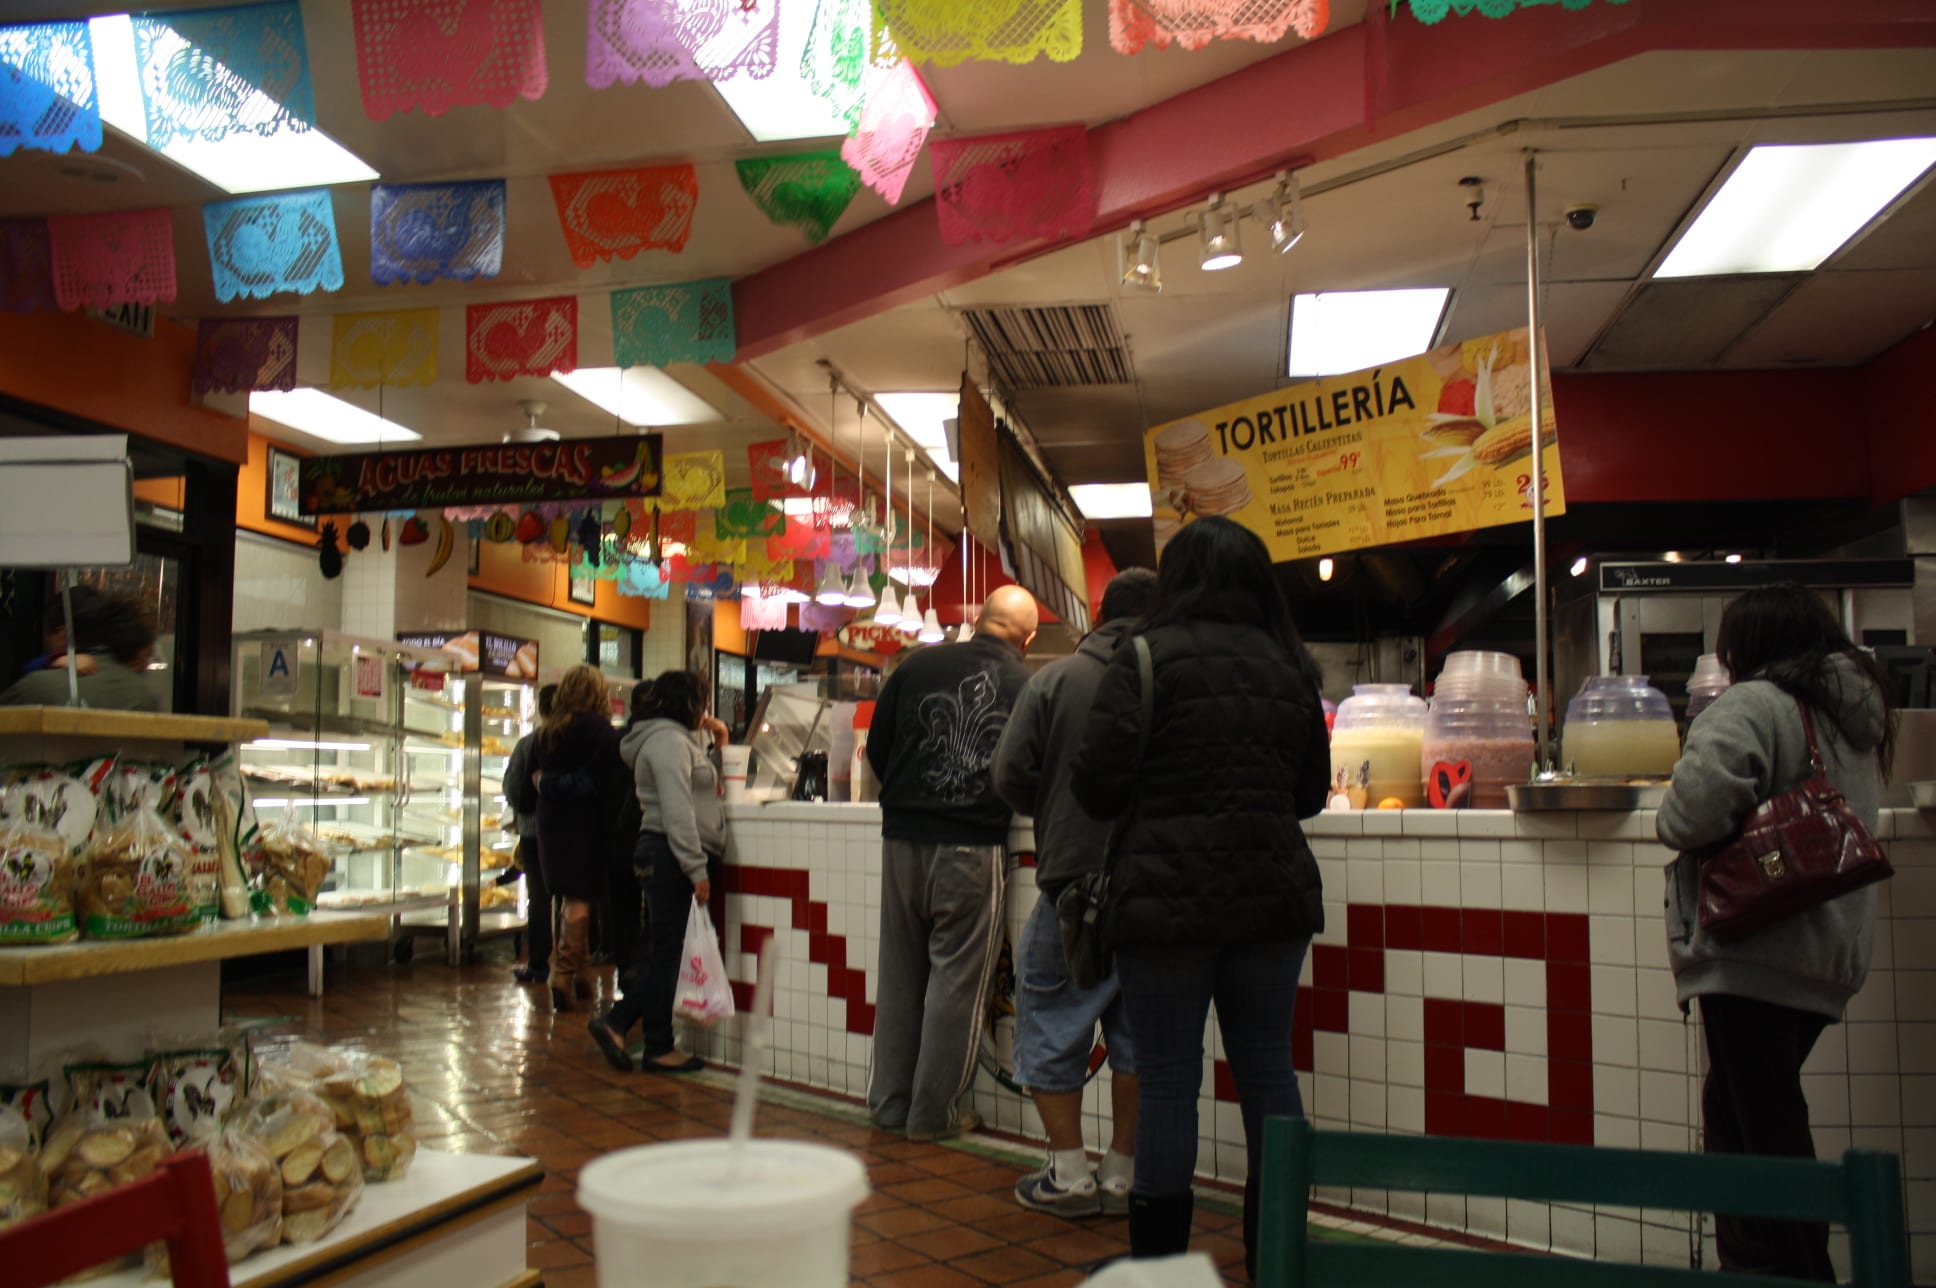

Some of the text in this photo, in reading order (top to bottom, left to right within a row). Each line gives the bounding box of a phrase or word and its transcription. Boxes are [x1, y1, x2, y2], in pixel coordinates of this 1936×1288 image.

[1216, 369, 1416, 455] TORTILLERÍA
[356, 445, 592, 500] AGUAS FRESCAS
[472, 477, 546, 499] naturales
[1624, 577, 1671, 586] BAXTER
[268, 649, 289, 678] A
